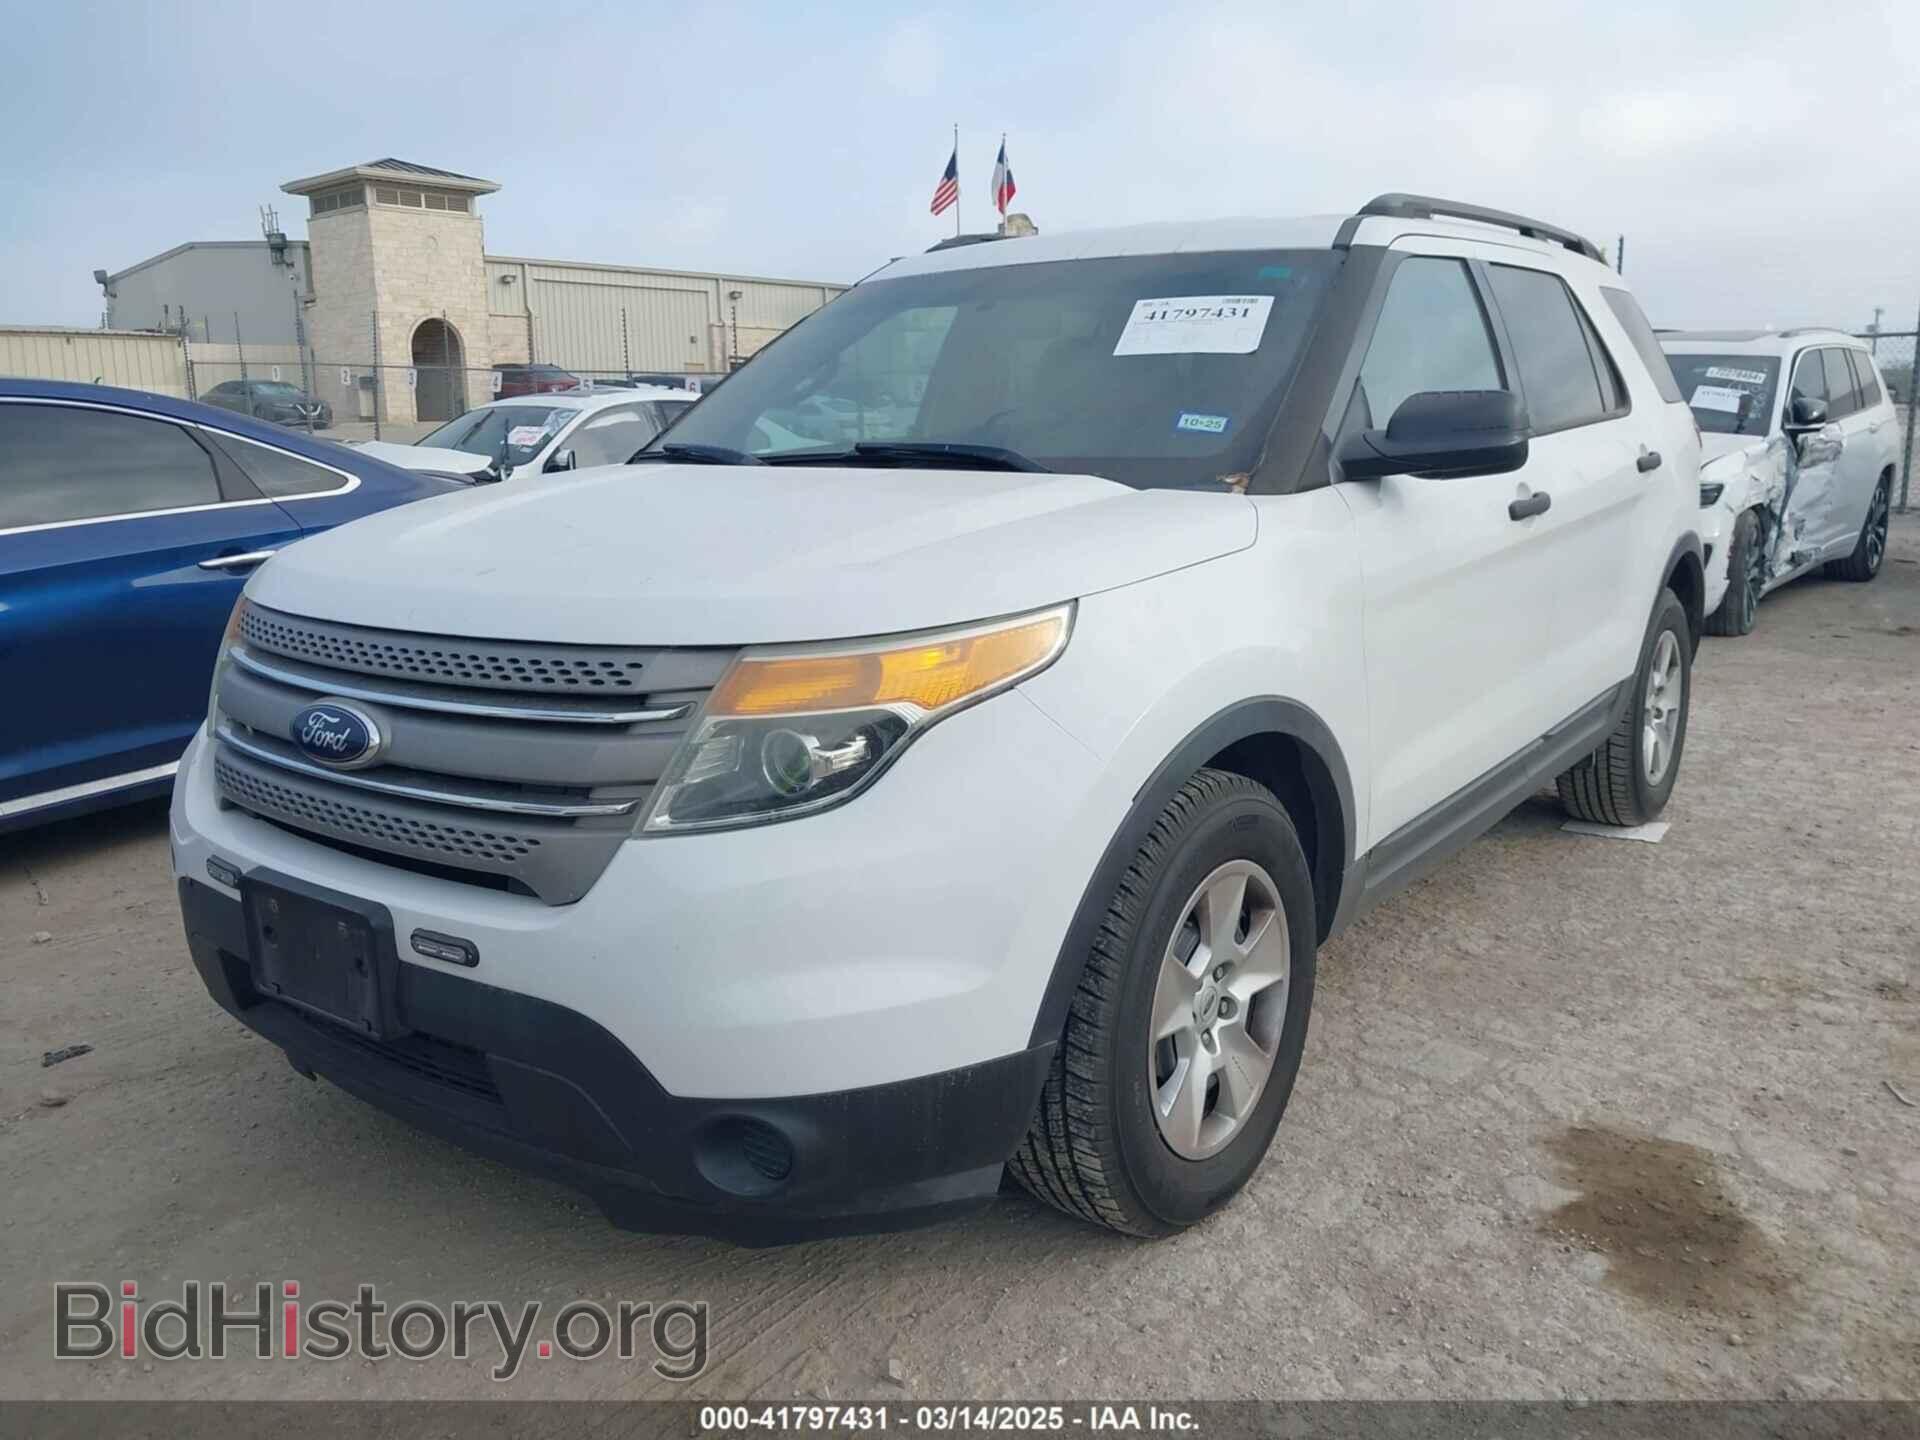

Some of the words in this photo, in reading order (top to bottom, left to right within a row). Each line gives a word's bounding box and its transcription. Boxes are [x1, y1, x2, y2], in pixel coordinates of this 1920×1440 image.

[1144, 306, 1249, 321] 41797431
[689, 381, 697, 393] 6
[302, 711, 351, 752] Ford
